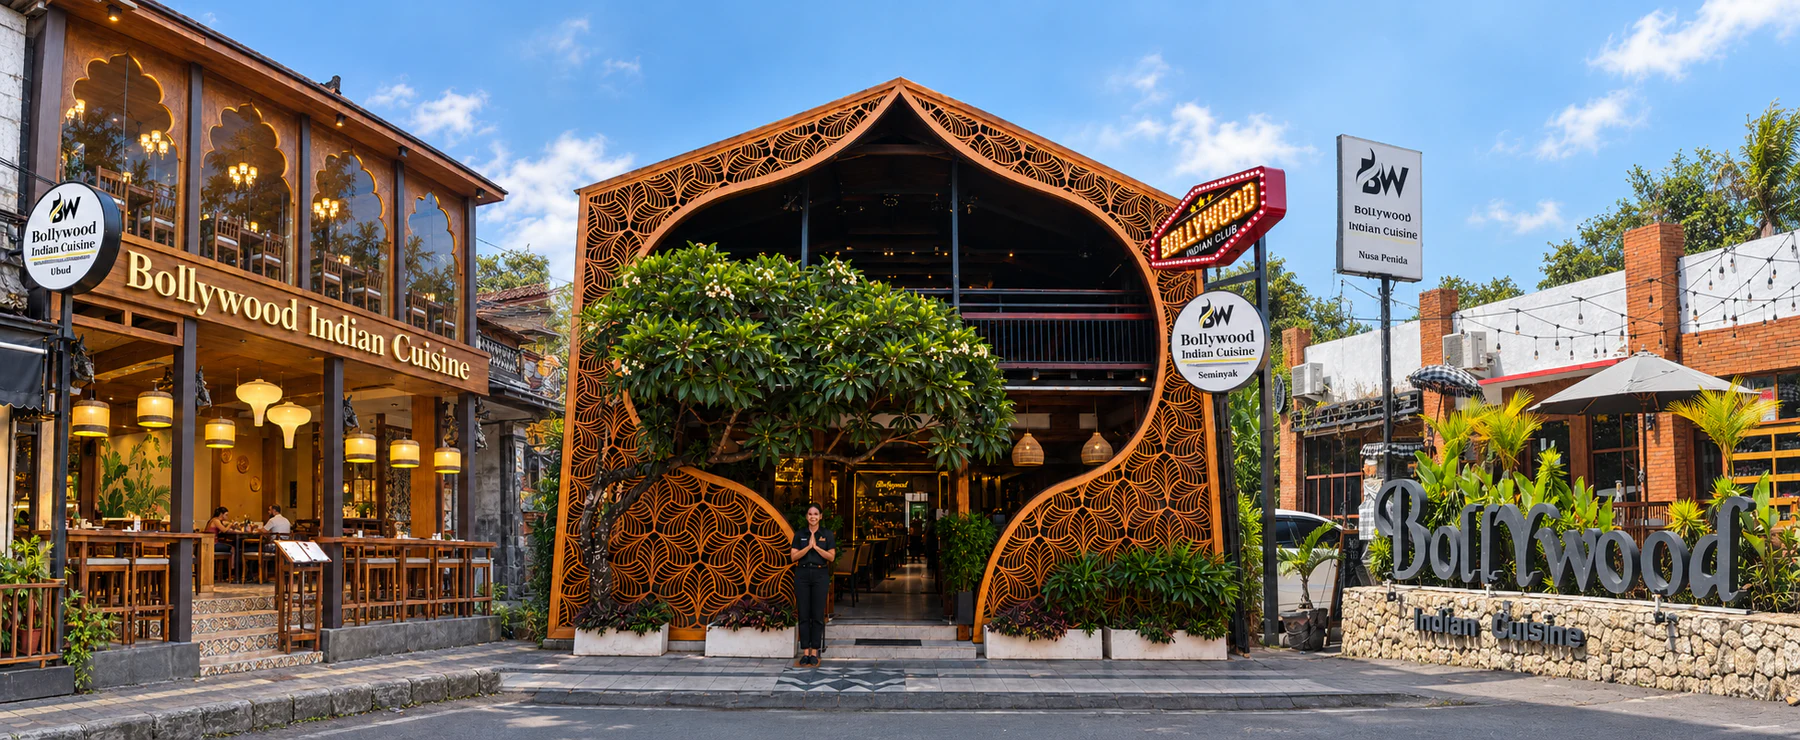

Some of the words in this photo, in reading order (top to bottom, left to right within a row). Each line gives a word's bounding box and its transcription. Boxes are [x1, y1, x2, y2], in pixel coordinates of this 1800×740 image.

[1160, 181, 1257, 259] BOLLYWOOD
[31, 220, 97, 243] Bollywood
[1186, 237, 1213, 257] INDIAN
[1214, 224, 1238, 243] CLUB
[1383, 226, 1418, 240] Cuisine
[31, 244, 59, 257] Indian
[60, 239, 96, 252] Cuisine
[1358, 250, 1380, 262] Nusa
[1381, 253, 1408, 265] Penida
[50, 265, 71, 276] Ubud
[127, 250, 299, 332] Bollywood
[308, 305, 385, 356] Indian
[391, 333, 471, 381] Cuisine
[1181, 329, 1255, 348] Bollywood
[1181, 348, 1214, 360] Indian
[1216, 346, 1255, 357] Cuisine
[1198, 368, 1238, 380] Seminyak
[1414, 607, 1481, 637] Indian
[1491, 610, 1587, 648] Cuisine
